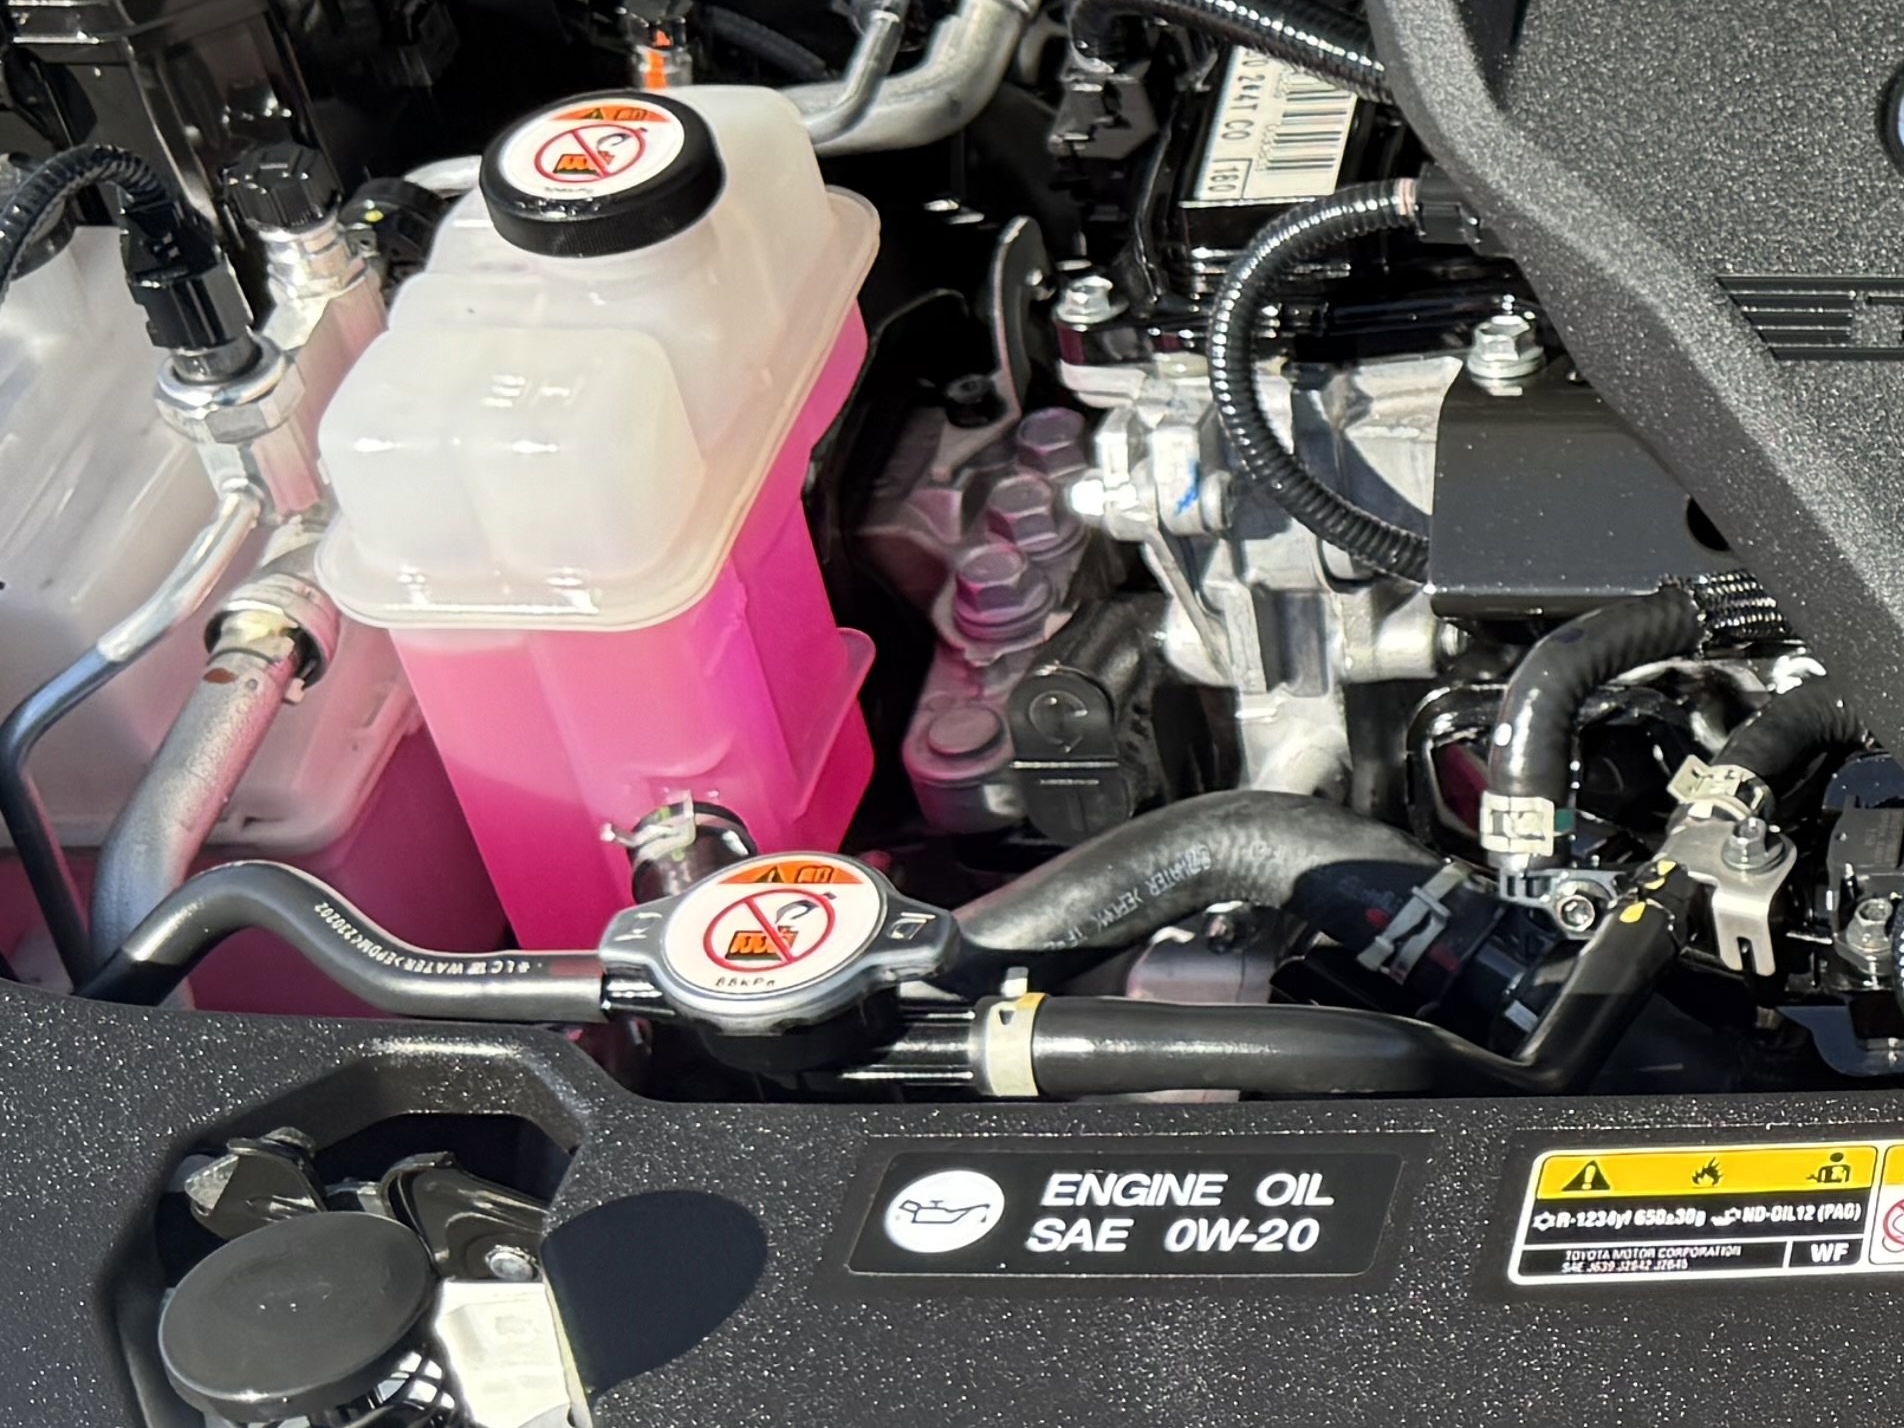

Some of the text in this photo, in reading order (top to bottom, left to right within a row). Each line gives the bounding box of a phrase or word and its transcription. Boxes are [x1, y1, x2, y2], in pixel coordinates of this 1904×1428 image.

[1040, 1172, 1335, 1207] ENGINE OIL
[1816, 1202, 1862, 1223] (PAG)
[1024, 1217, 1321, 1253] SAE 0W-20
[1565, 1245, 1742, 1262] TOYOTA MOTOR CORPORATION
[1809, 1242, 1850, 1263] WF
